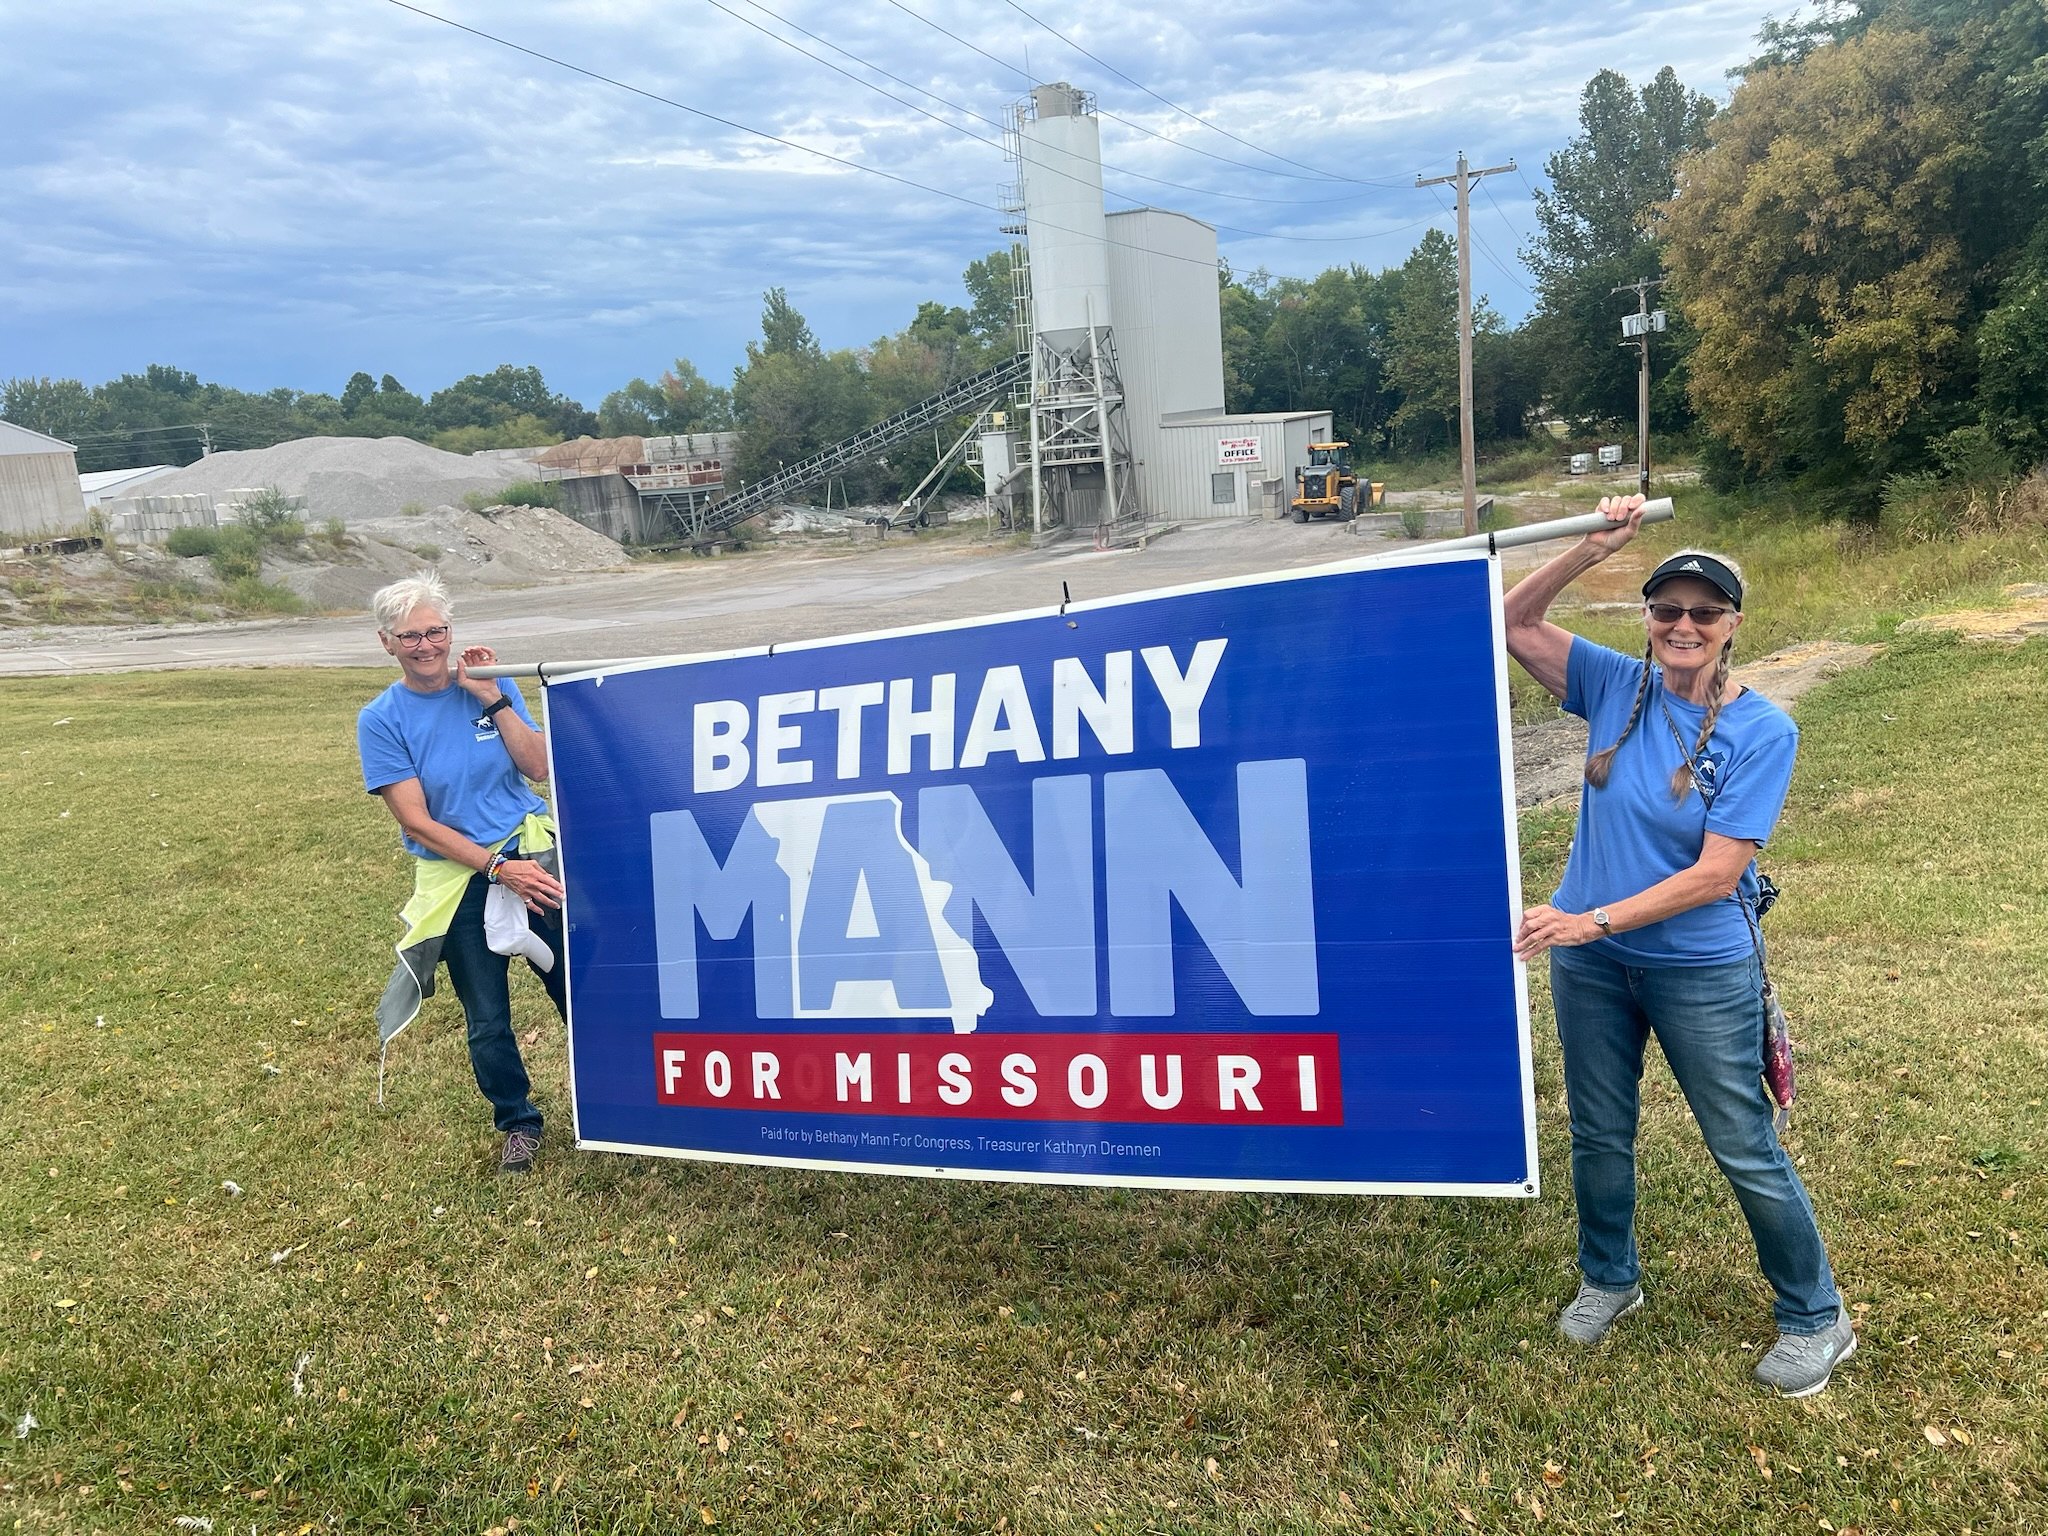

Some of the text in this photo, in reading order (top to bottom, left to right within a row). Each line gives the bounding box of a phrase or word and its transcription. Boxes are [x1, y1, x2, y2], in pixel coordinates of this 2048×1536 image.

[1224, 449, 1256, 457] OFFICE
[693, 638, 1228, 793] BETHANY
[650, 758, 1320, 1019] MANN
[663, 1050, 1318, 1112] FOR MISSOURI
[761, 1126, 1161, 1158] Paid for by Bethany Mann For Congress, Treasurer Kathryn Drennen
